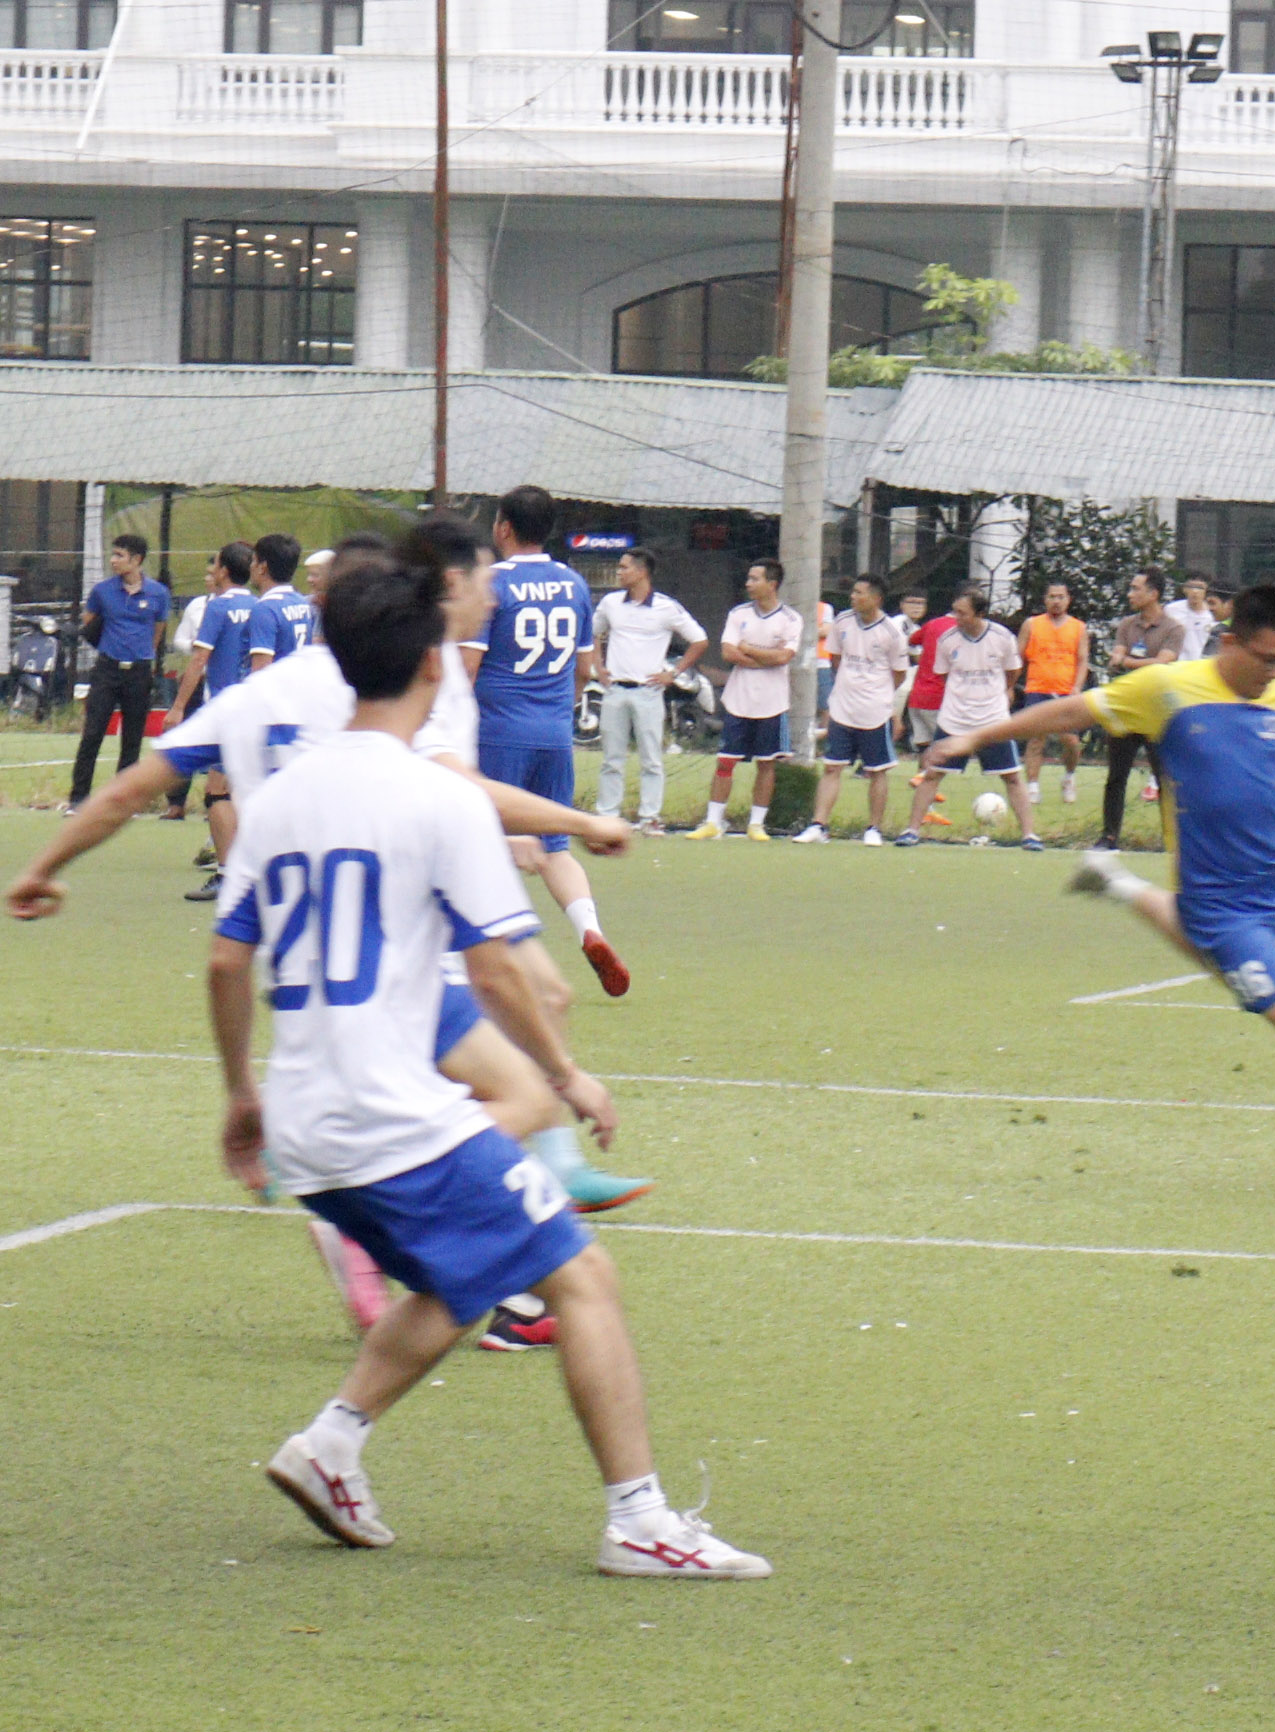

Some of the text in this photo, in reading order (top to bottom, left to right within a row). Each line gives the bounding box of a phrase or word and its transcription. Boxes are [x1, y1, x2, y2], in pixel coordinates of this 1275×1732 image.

[281, 604, 311, 621] VNPT
[509, 581, 575, 601] VNPT
[513, 607, 577, 674] 99
[265, 847, 384, 1011] 20
[503, 1156, 571, 1225] 2
